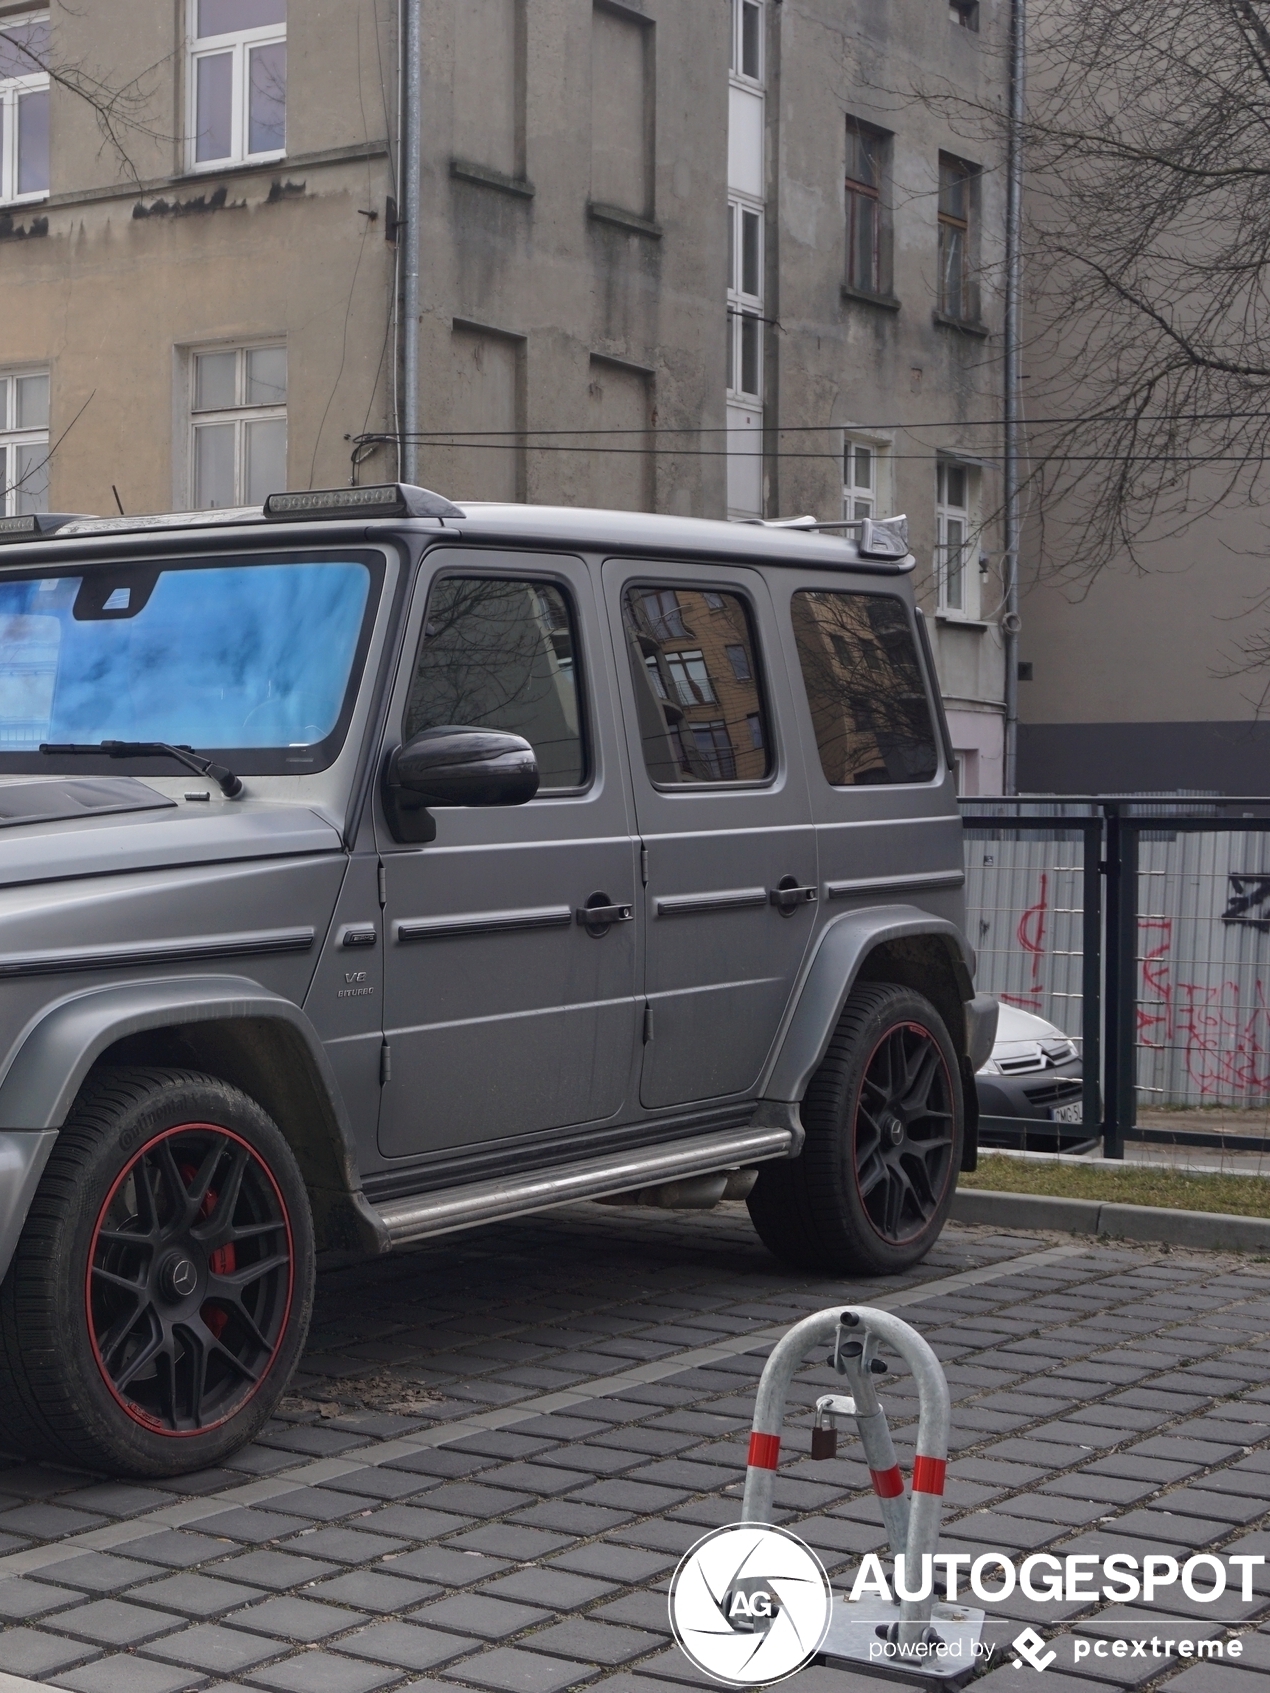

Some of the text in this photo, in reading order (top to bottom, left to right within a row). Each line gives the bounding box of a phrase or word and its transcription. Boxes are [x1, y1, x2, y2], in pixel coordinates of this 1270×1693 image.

[345, 971, 367, 983] V8
[337, 987, 374, 997] BITURBO
[118, 1094, 189, 1152] Continental
